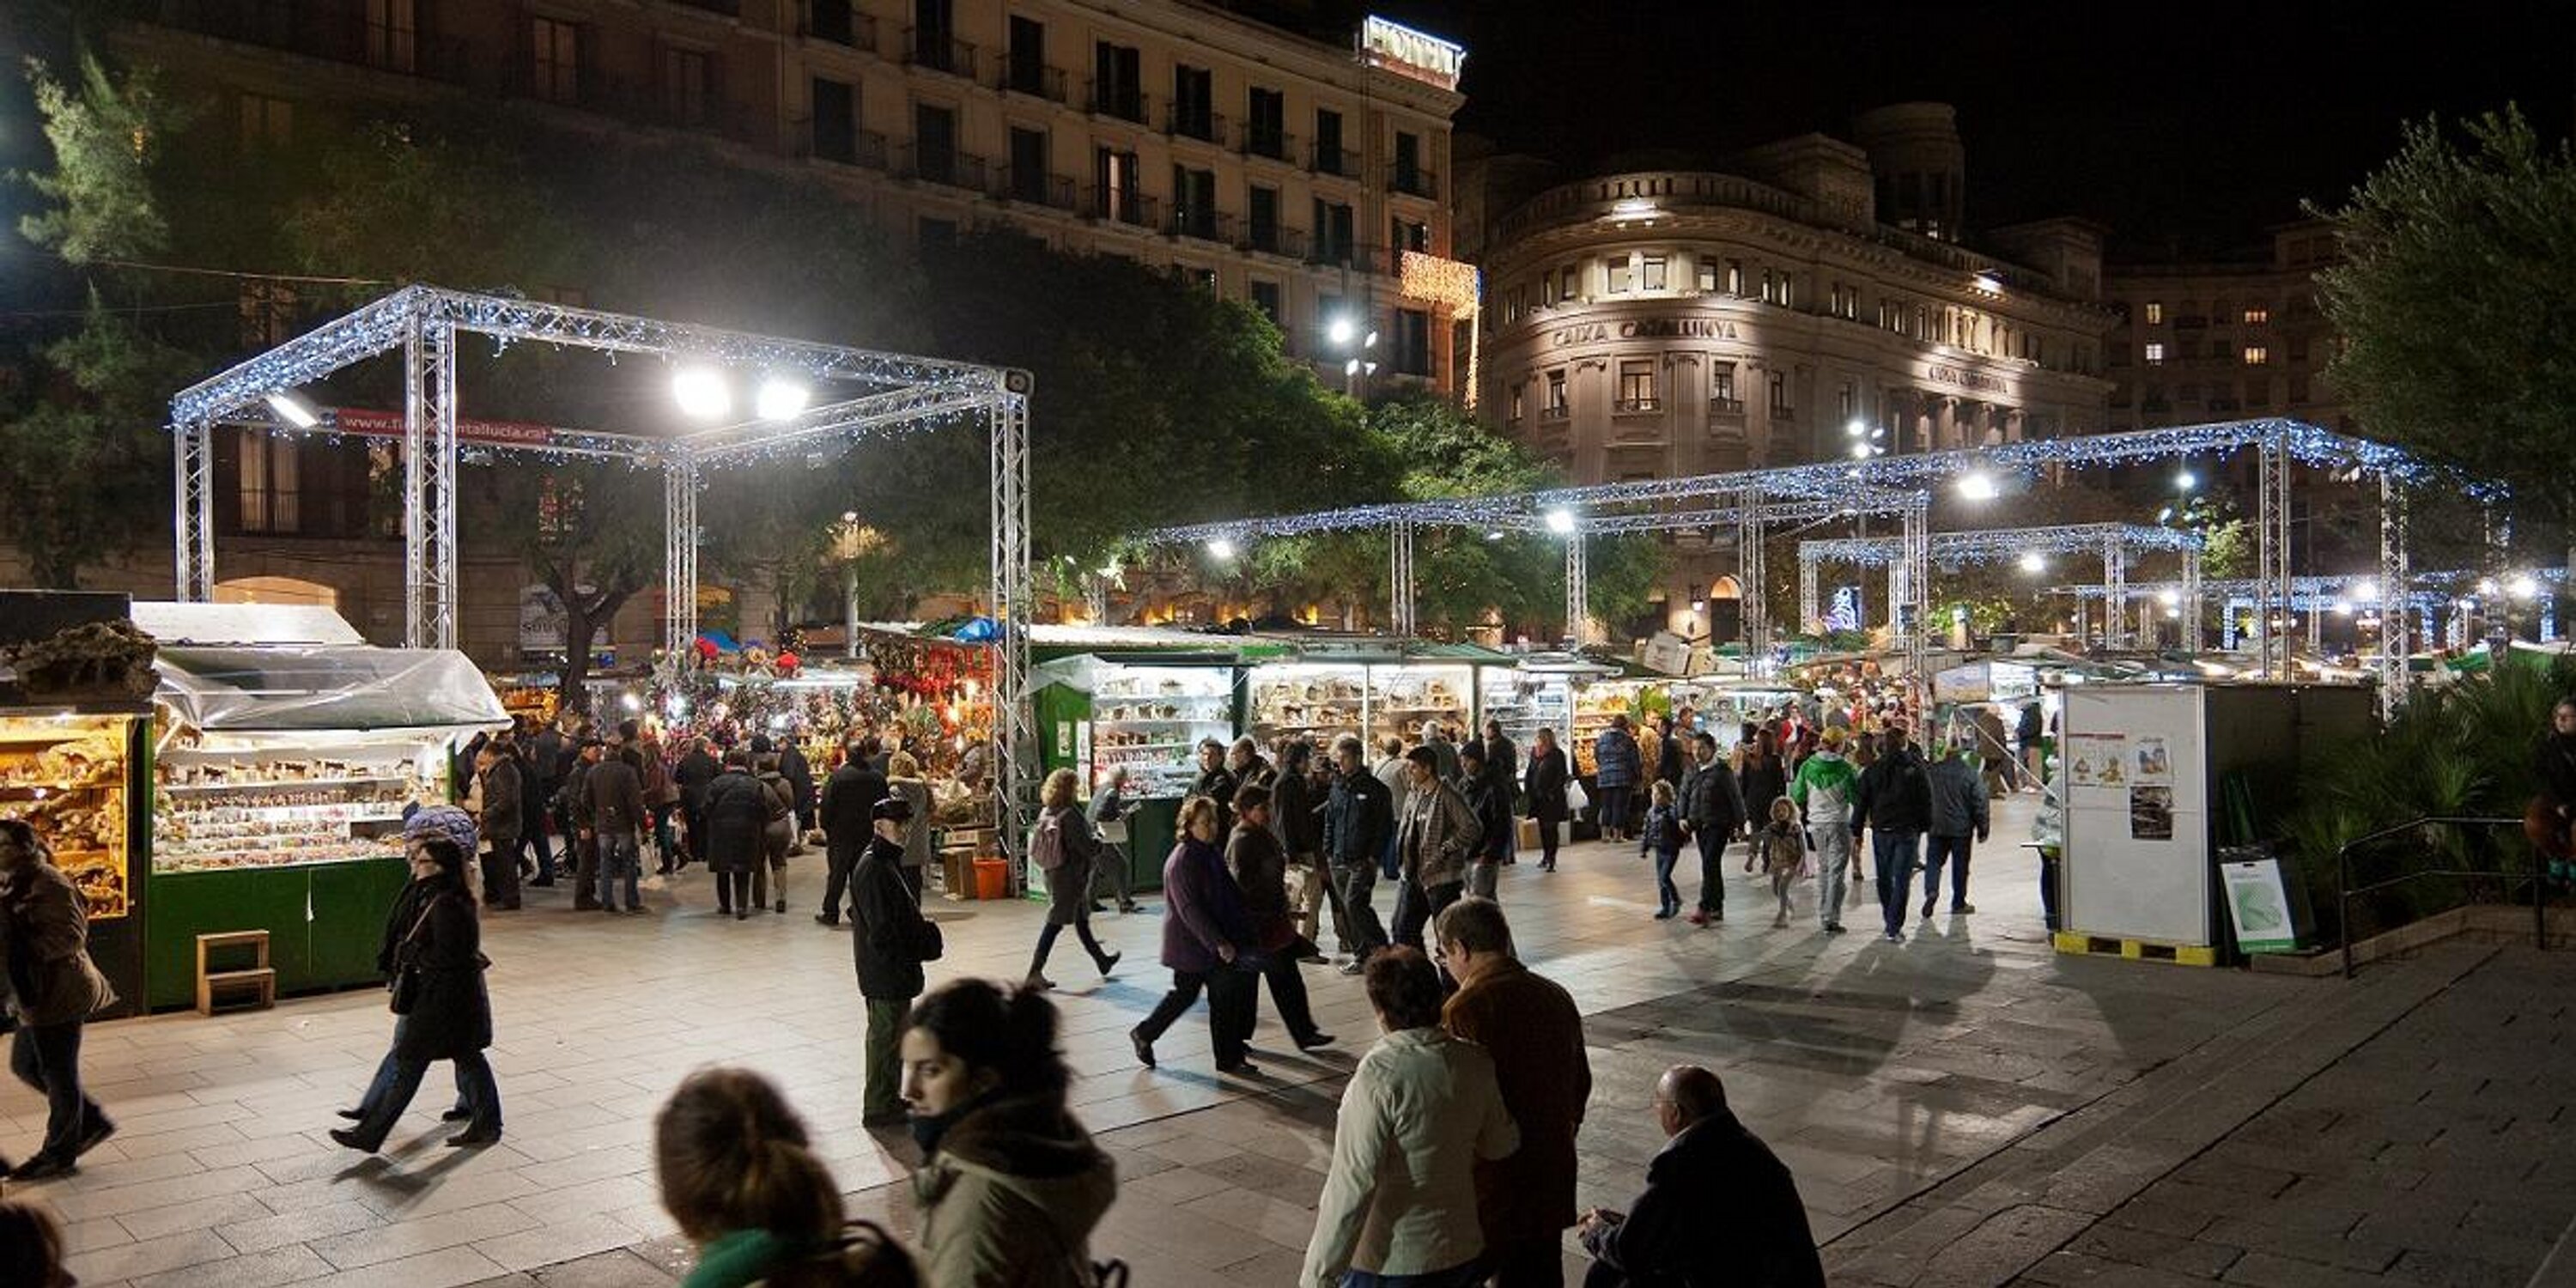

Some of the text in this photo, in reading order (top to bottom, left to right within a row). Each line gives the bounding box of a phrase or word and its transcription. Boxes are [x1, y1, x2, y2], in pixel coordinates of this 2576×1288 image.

[1554, 319, 1739, 345] CAIXA CATALUNYA
[344, 417, 548, 440] www.fintallucia.cat
